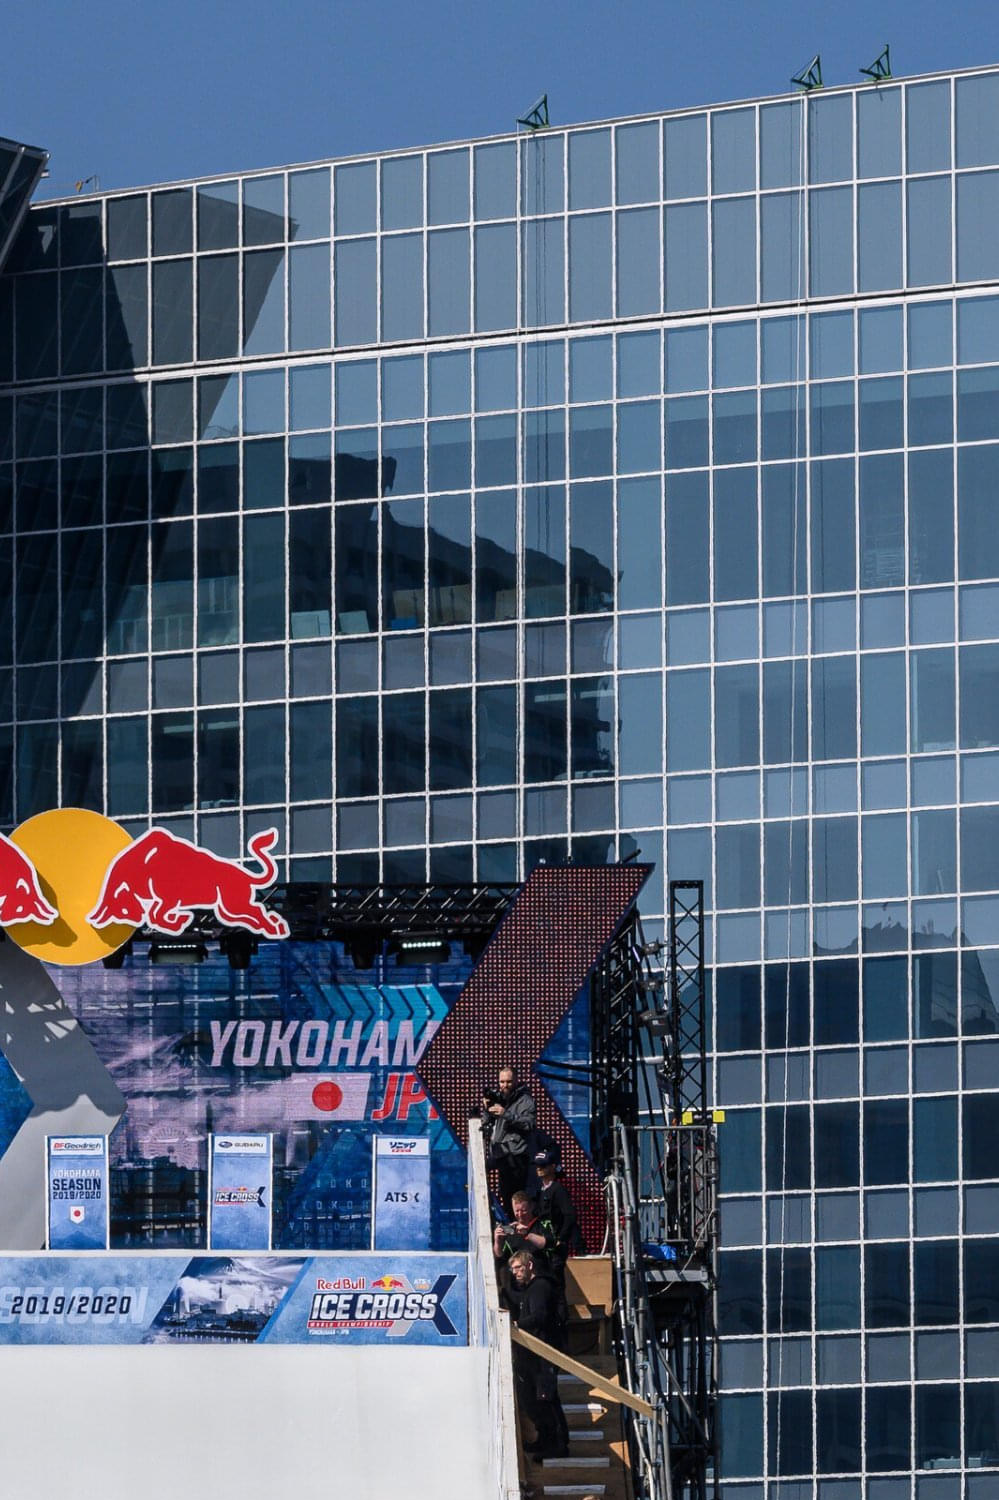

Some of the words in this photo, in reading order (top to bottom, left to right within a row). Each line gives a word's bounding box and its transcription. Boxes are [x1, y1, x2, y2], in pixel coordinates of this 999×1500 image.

[210, 1020, 441, 1067] YOKOHAM
[52, 1178, 101, 1191] SEASON
[52, 1190, 101, 1200] 2019/2020
[317, 1279, 341, 1291] Red
[342, 1278, 365, 1291] Bull
[11, 1296, 132, 1315] 2019/2020
[312, 1294, 353, 1320] ICE
[355, 1294, 438, 1320] CROSS
